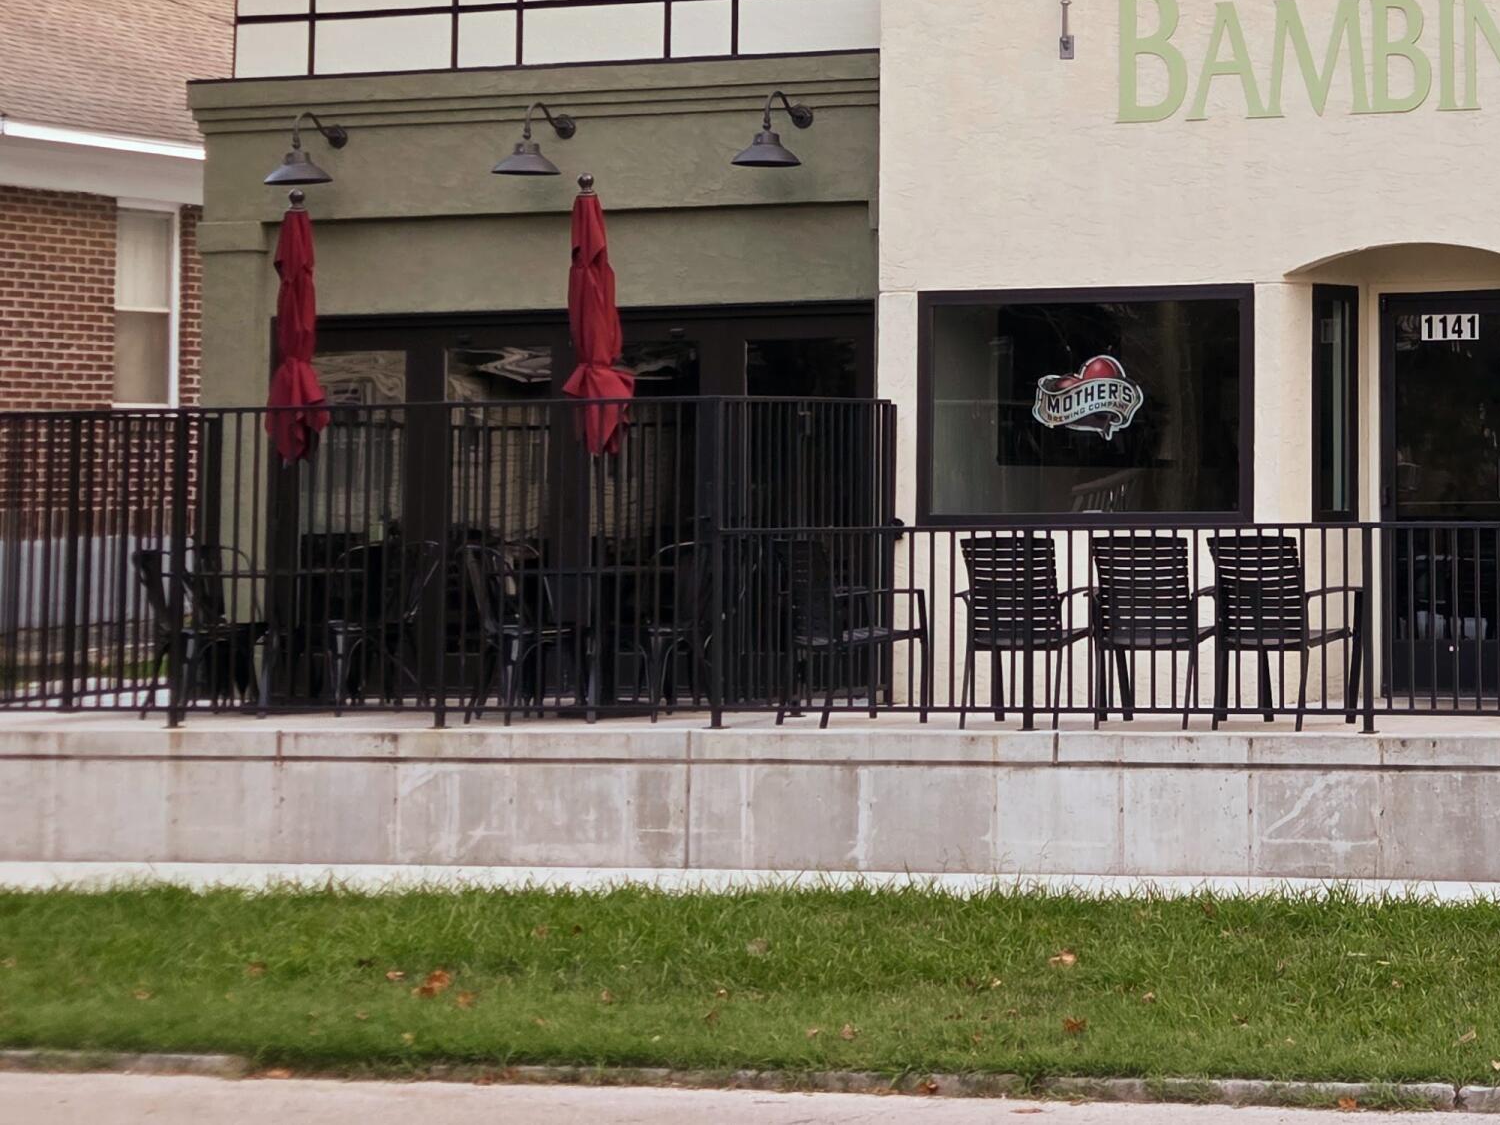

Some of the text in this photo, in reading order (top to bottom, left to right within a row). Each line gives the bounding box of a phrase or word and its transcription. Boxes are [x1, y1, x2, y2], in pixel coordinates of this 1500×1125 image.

[1425, 315, 1476, 339] 1141
[1047, 382, 1132, 414] MOTHER'S
[1047, 401, 1129, 422] BREWING COMPANY
